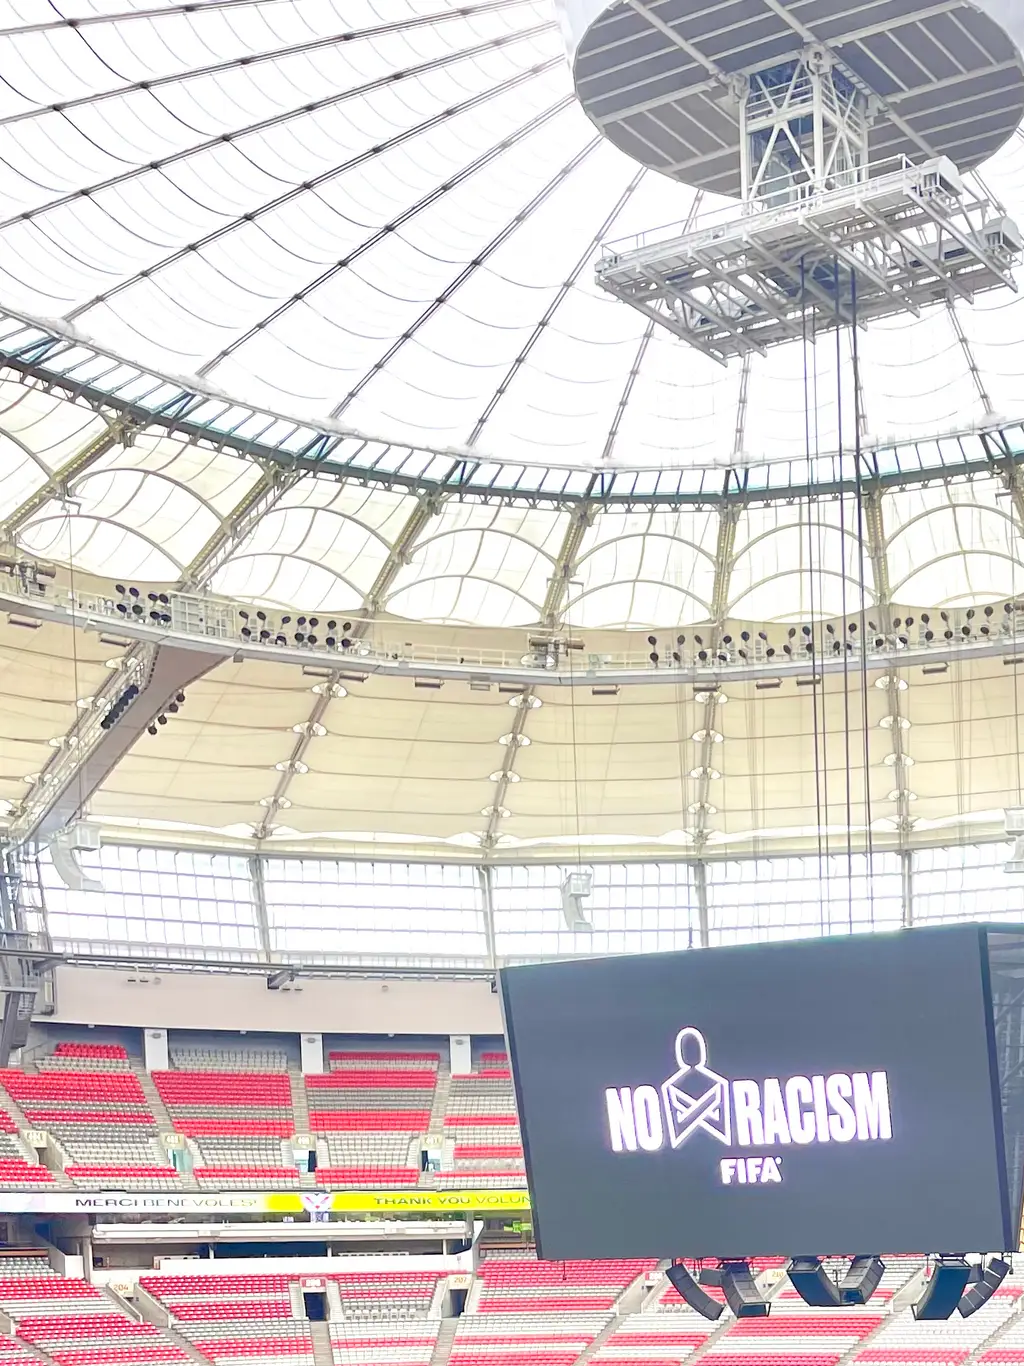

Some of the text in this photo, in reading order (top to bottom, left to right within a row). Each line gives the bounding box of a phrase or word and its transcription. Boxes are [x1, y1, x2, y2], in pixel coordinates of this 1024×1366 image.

[605, 1070, 893, 1152] NO RACISM
[720, 1156, 784, 1184] FIFA
[75, 1198, 138, 1207] MERCI
[374, 1197, 432, 1205] THANK
[437, 1196, 471, 1204] YOU
[454, 1276, 467, 1284] 207
[113, 1283, 129, 1291] 204
